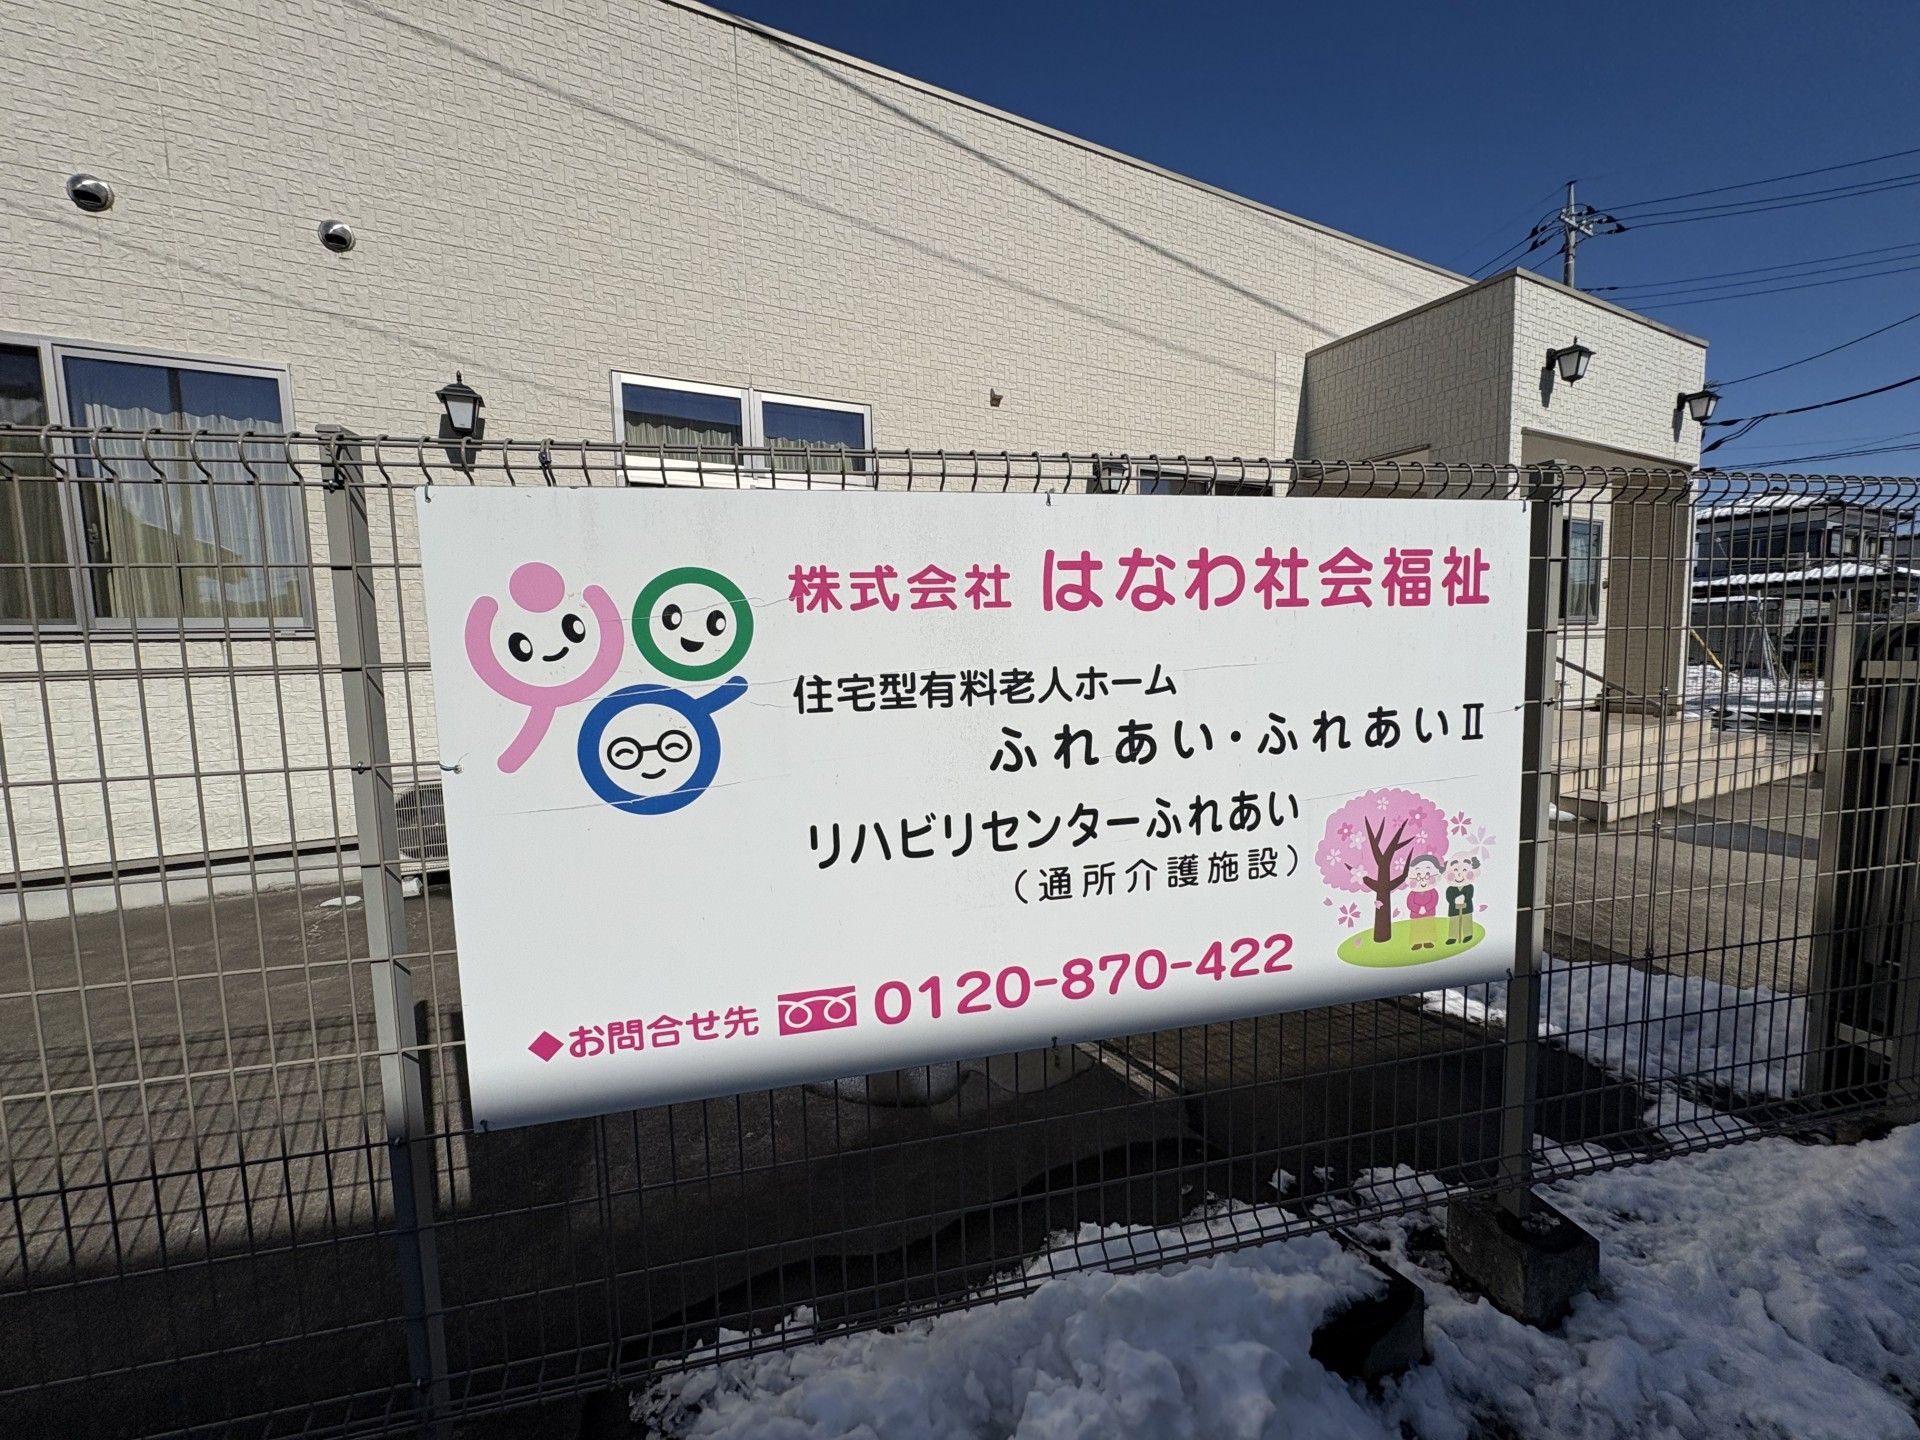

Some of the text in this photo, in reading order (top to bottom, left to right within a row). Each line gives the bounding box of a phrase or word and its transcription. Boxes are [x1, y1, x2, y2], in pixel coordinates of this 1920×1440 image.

[788, 546, 1490, 614] 株式会社 はなわ社会福祉
[793, 664, 1177, 715] 住宅型有料老人ホーム
[809, 790, 1299, 870] リハビリセンターふれあい
[1014, 844, 1299, 904] (通所介護施設)
[568, 933, 1294, 1058] お問合せ先 0120-870-422
